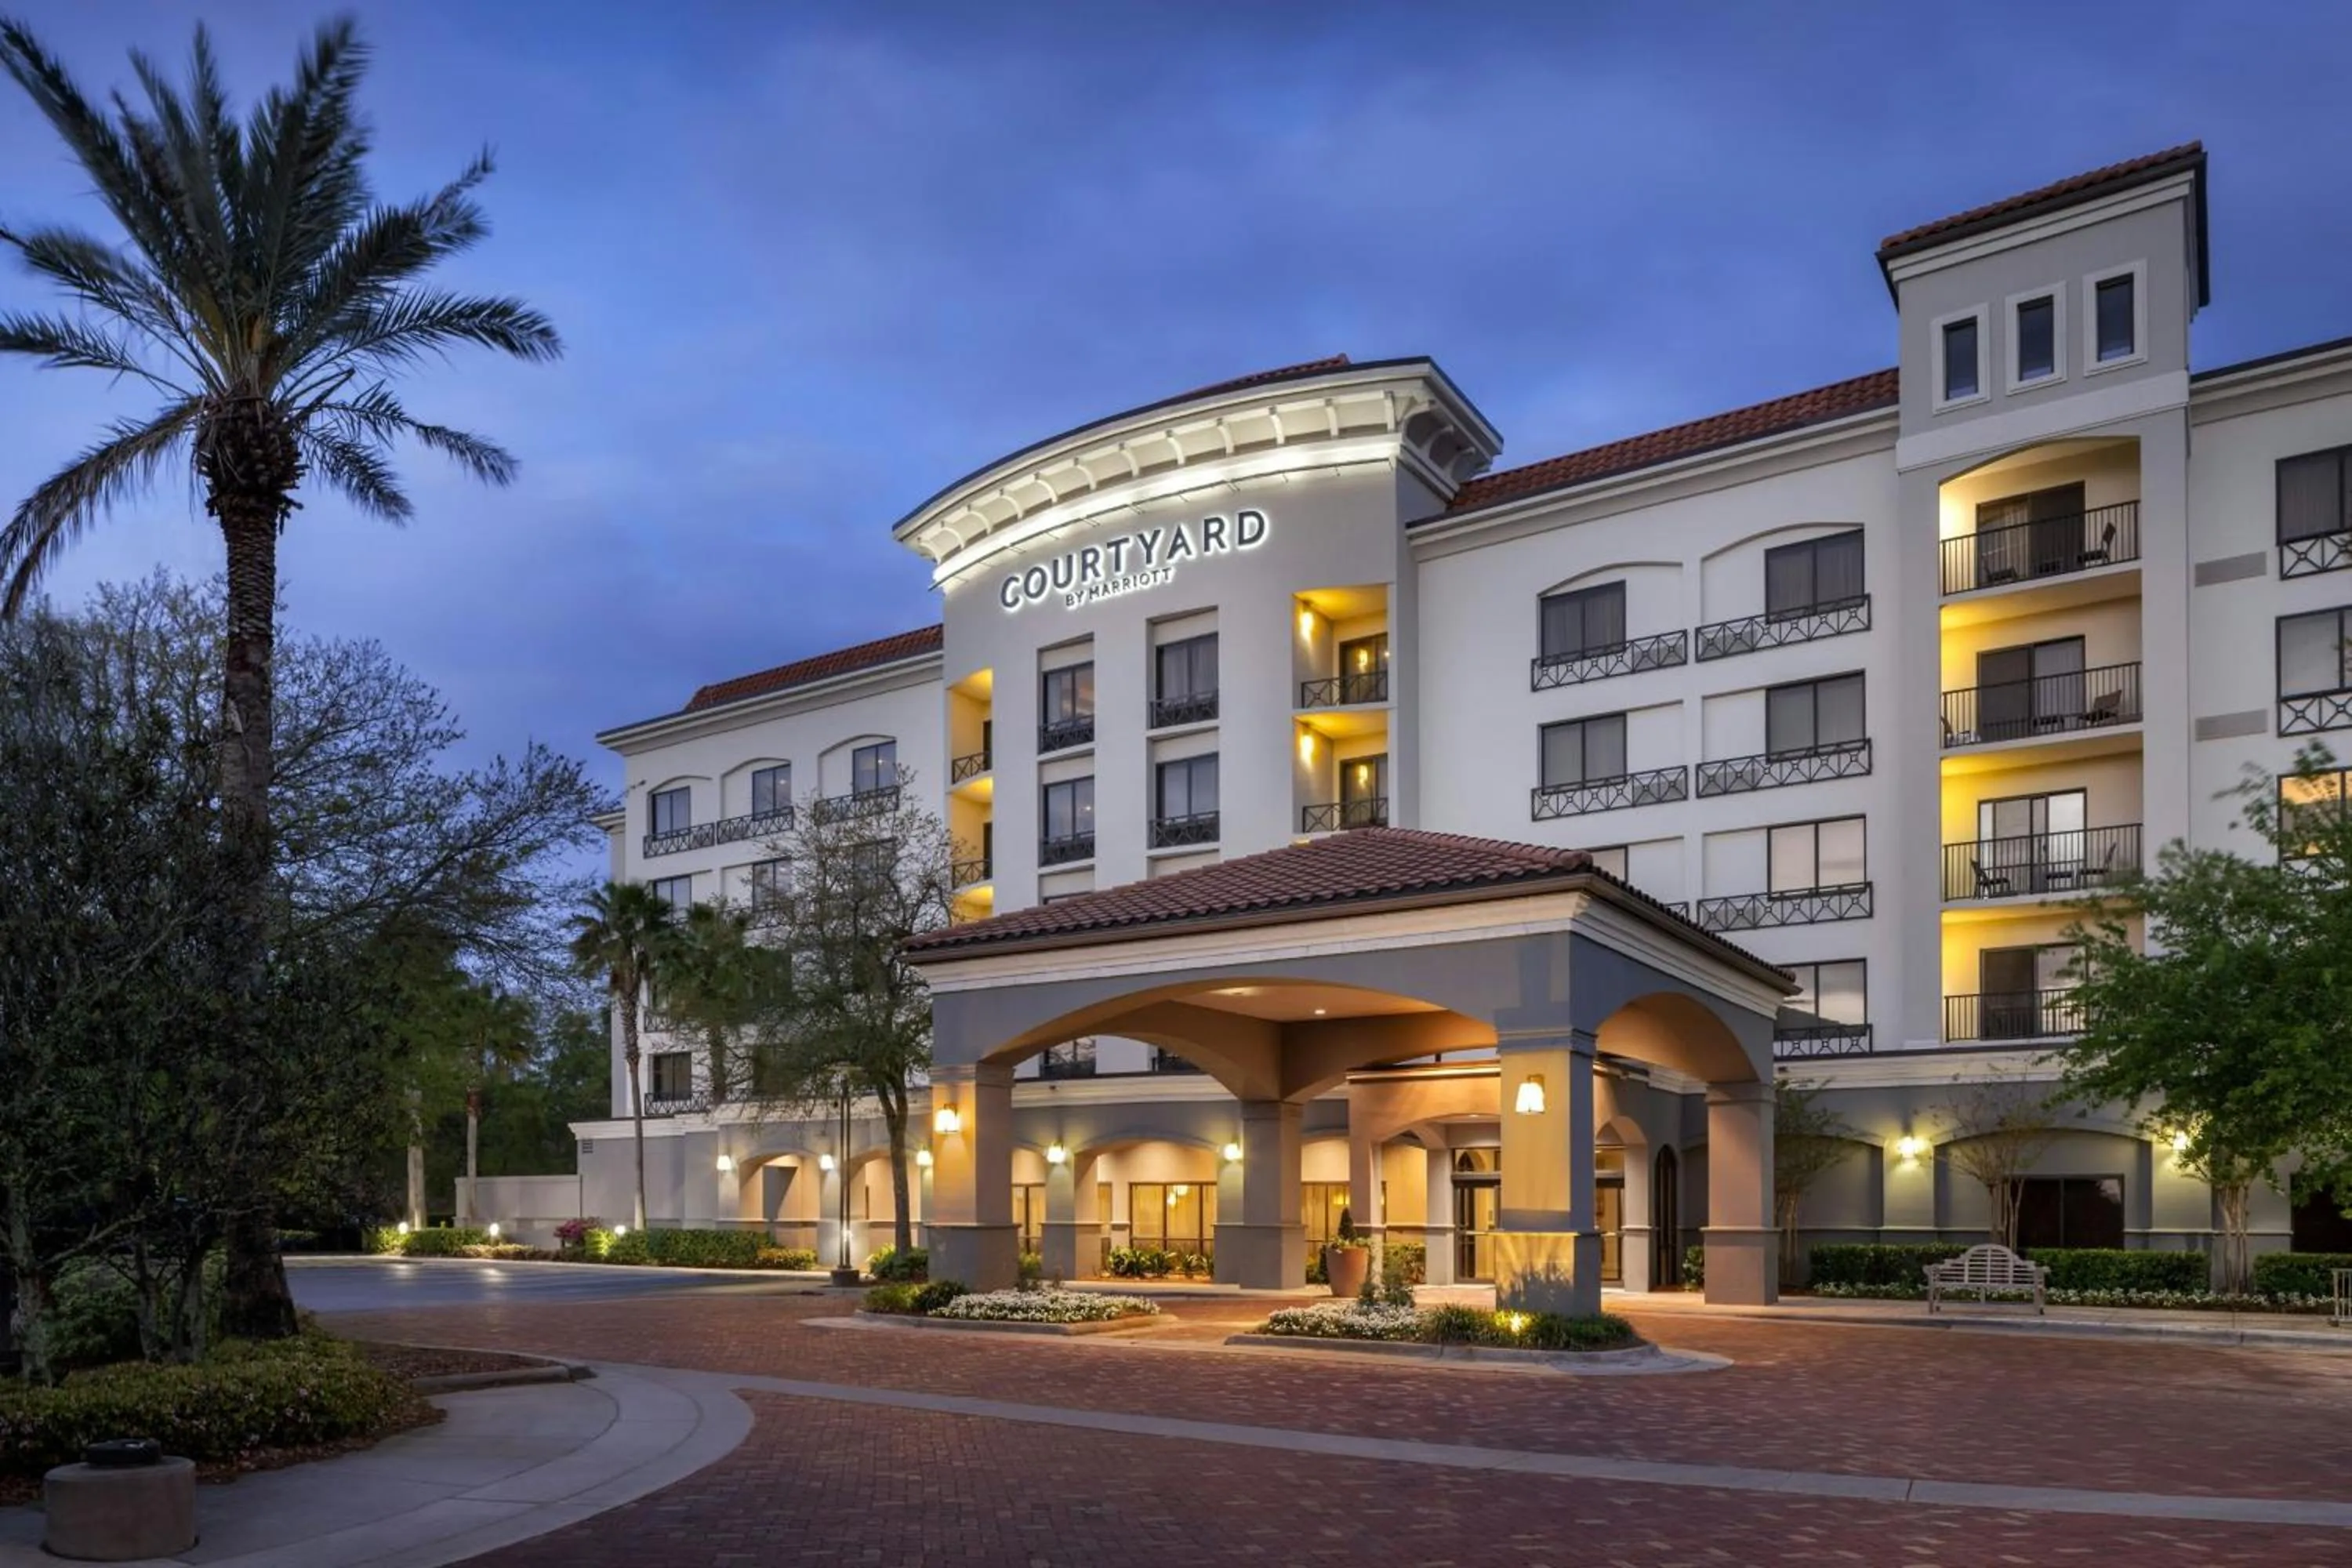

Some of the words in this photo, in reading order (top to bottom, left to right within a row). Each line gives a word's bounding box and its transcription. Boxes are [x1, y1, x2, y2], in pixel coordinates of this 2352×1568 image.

[1000, 510, 1266, 608] COURTYARD
[1065, 590, 1084, 607] BY
[1089, 568, 1172, 601] MARRIOTT
